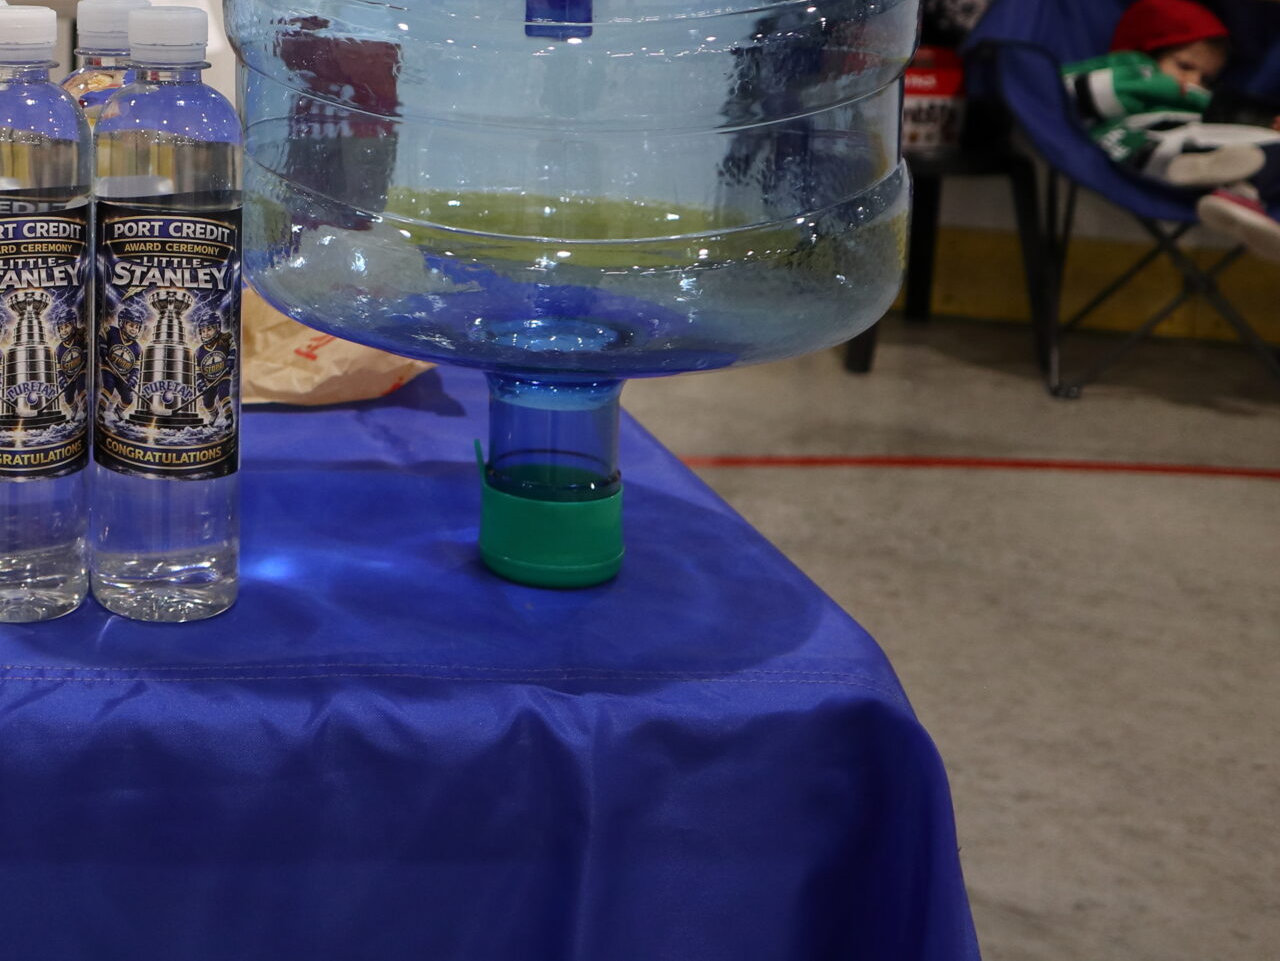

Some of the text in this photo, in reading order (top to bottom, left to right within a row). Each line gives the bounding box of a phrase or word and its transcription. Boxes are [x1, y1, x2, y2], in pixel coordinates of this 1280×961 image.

[22, 222, 82, 239] CREDIT
[113, 221, 230, 243] PORT CREDIT
[20, 243, 72, 253] CEREMONY
[124, 243, 220, 255] AWARD CEREMONY
[0, 257, 56, 269] LITTLE
[143, 256, 202, 268] LITTLE
[112, 261, 228, 290] STANLEY
[106, 438, 222, 464] CONGRATULATIONS
